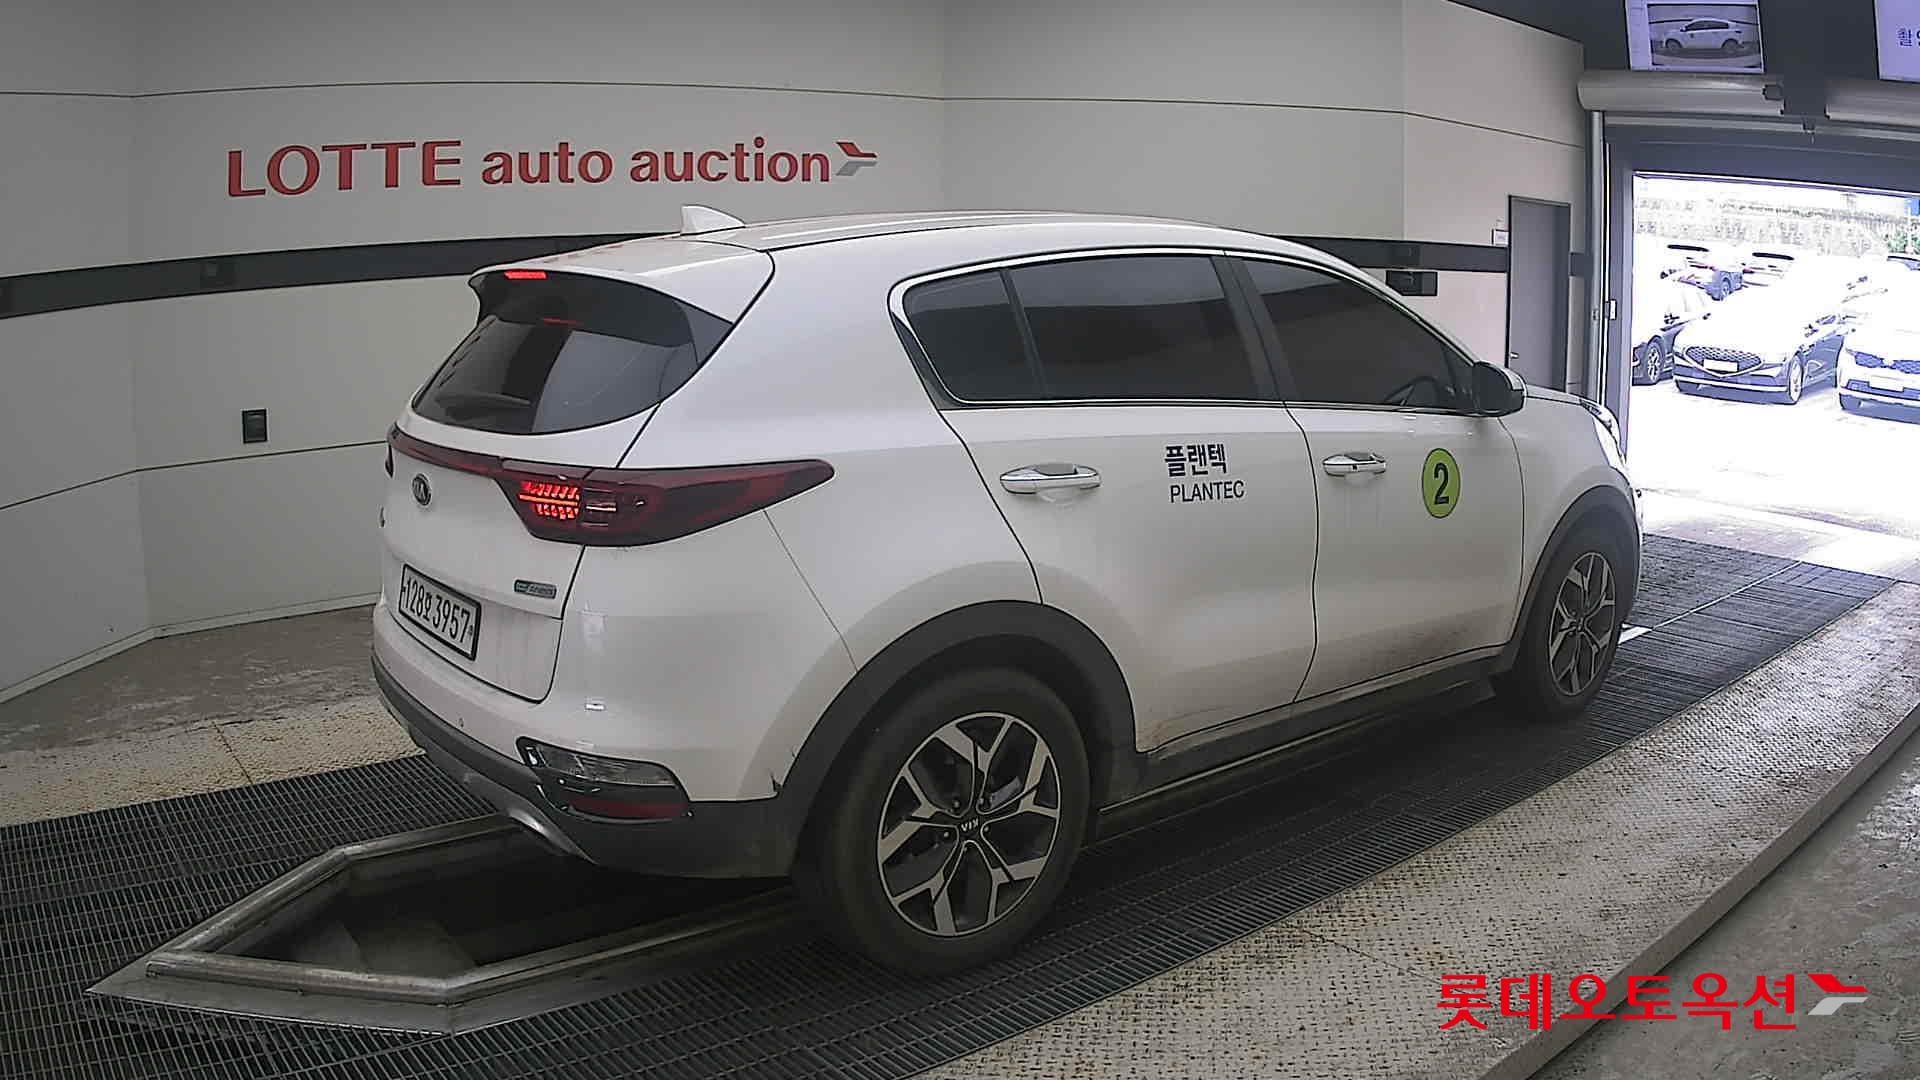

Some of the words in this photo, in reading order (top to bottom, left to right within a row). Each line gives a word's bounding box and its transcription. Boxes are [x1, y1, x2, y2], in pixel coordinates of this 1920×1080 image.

[228, 140, 462, 197] LOTTE
[481, 141, 613, 184] auto
[630, 136, 830, 183] auction
[1164, 443, 1227, 477] 플랜텍
[1170, 480, 1244, 503] PLANTEC
[1434, 462, 1450, 505] 2
